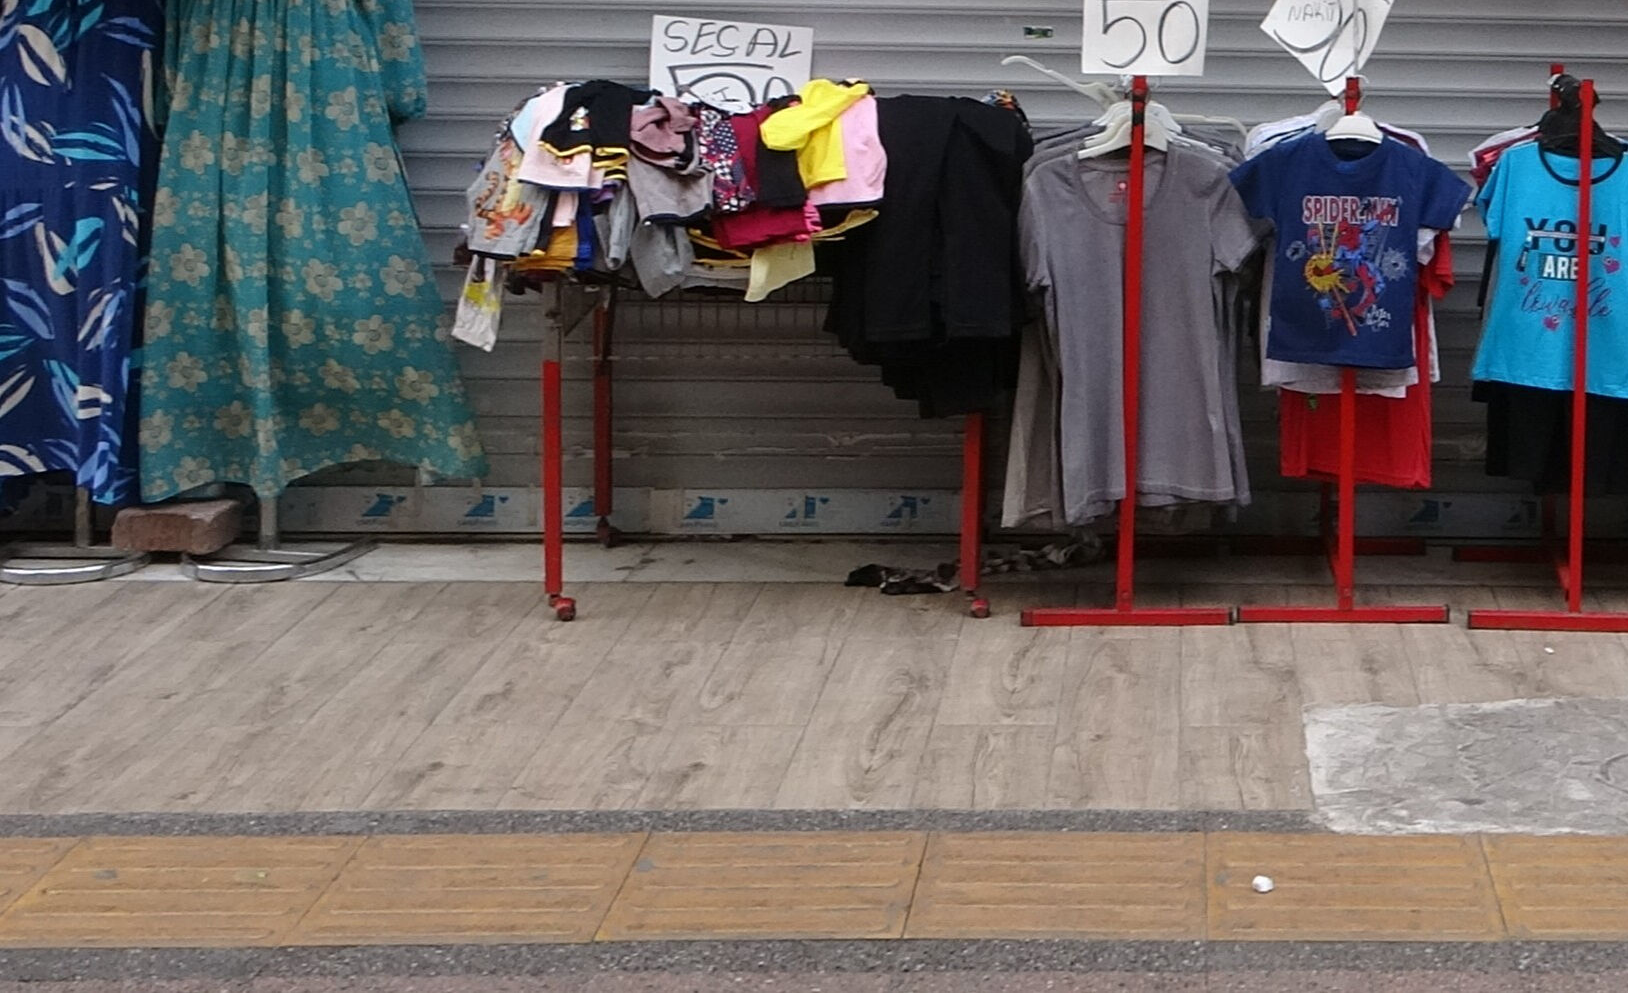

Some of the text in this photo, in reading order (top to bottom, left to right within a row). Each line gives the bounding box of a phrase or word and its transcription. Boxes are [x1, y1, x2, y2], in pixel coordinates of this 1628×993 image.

[663, 20, 802, 59] SEÇ AL
[1523, 217, 1608, 256] YOU
[1542, 255, 1580, 280] ARE
